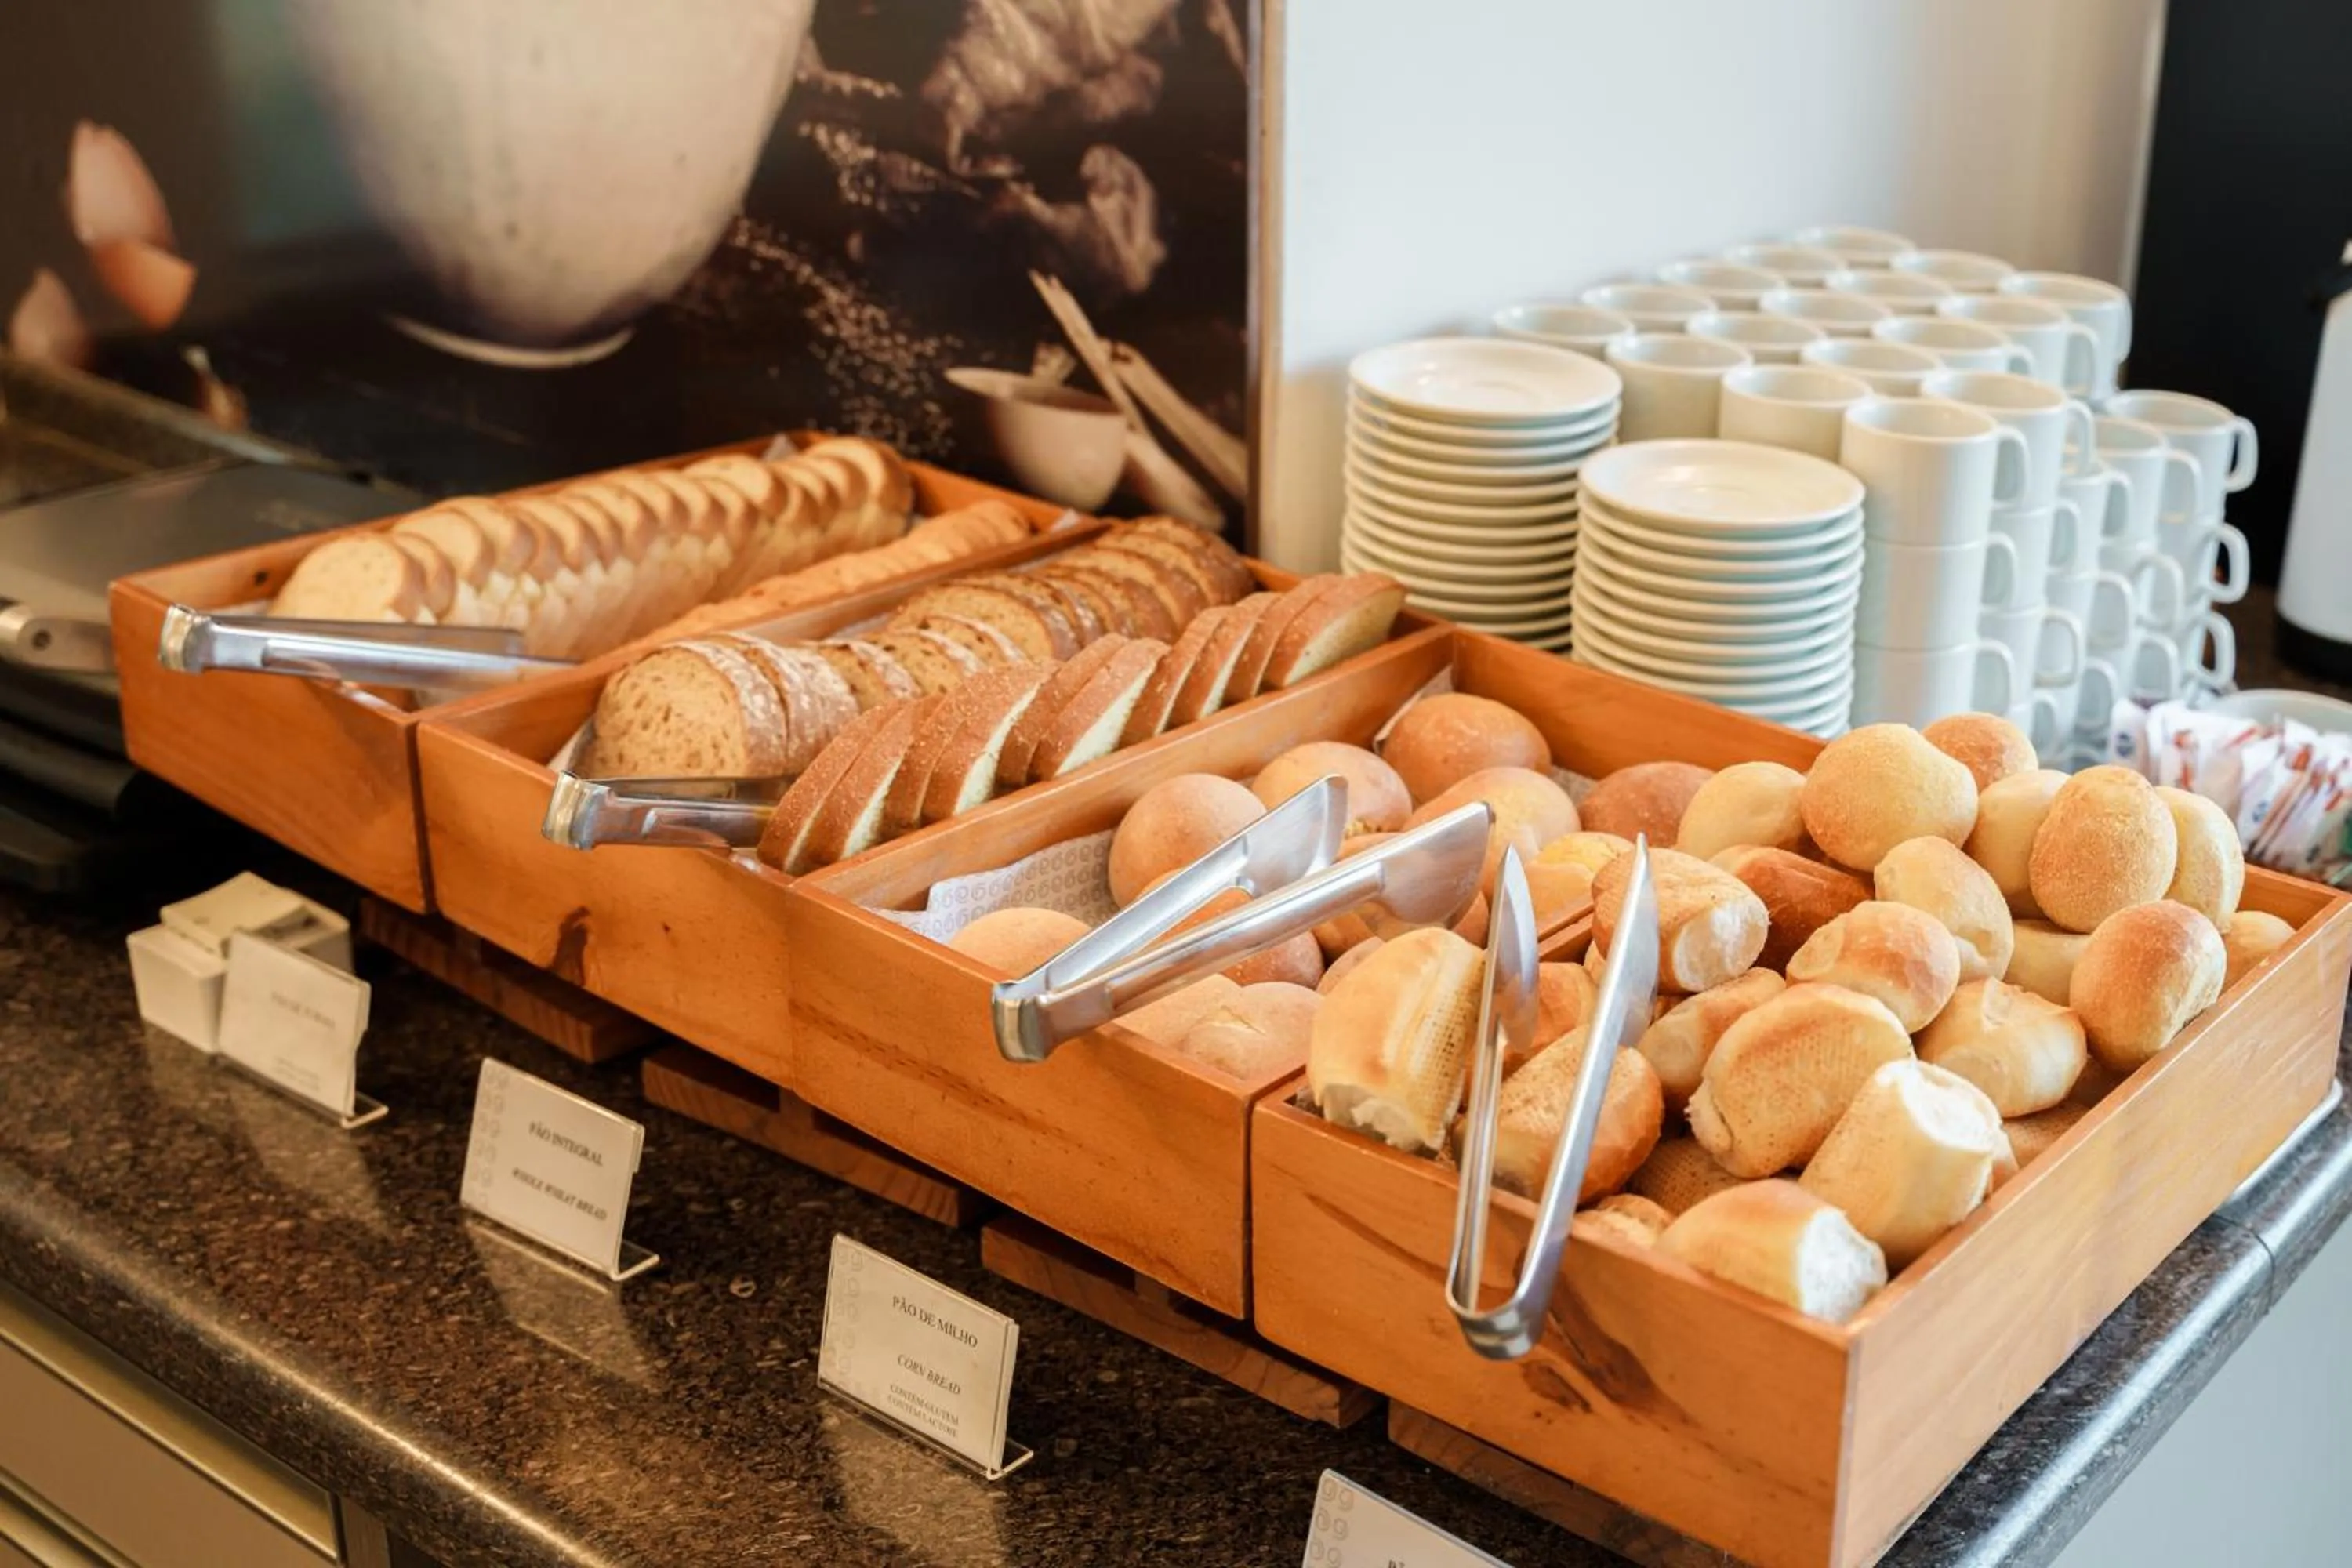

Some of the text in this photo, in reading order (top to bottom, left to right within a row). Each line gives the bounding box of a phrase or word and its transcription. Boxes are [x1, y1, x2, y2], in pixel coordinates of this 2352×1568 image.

[551, 1132, 603, 1167] INTEGRAL
[576, 1199, 608, 1221] BREAD
[892, 1295, 978, 1348] PÃO DE MILHO
[898, 1354, 961, 1395] CORN BREAD
